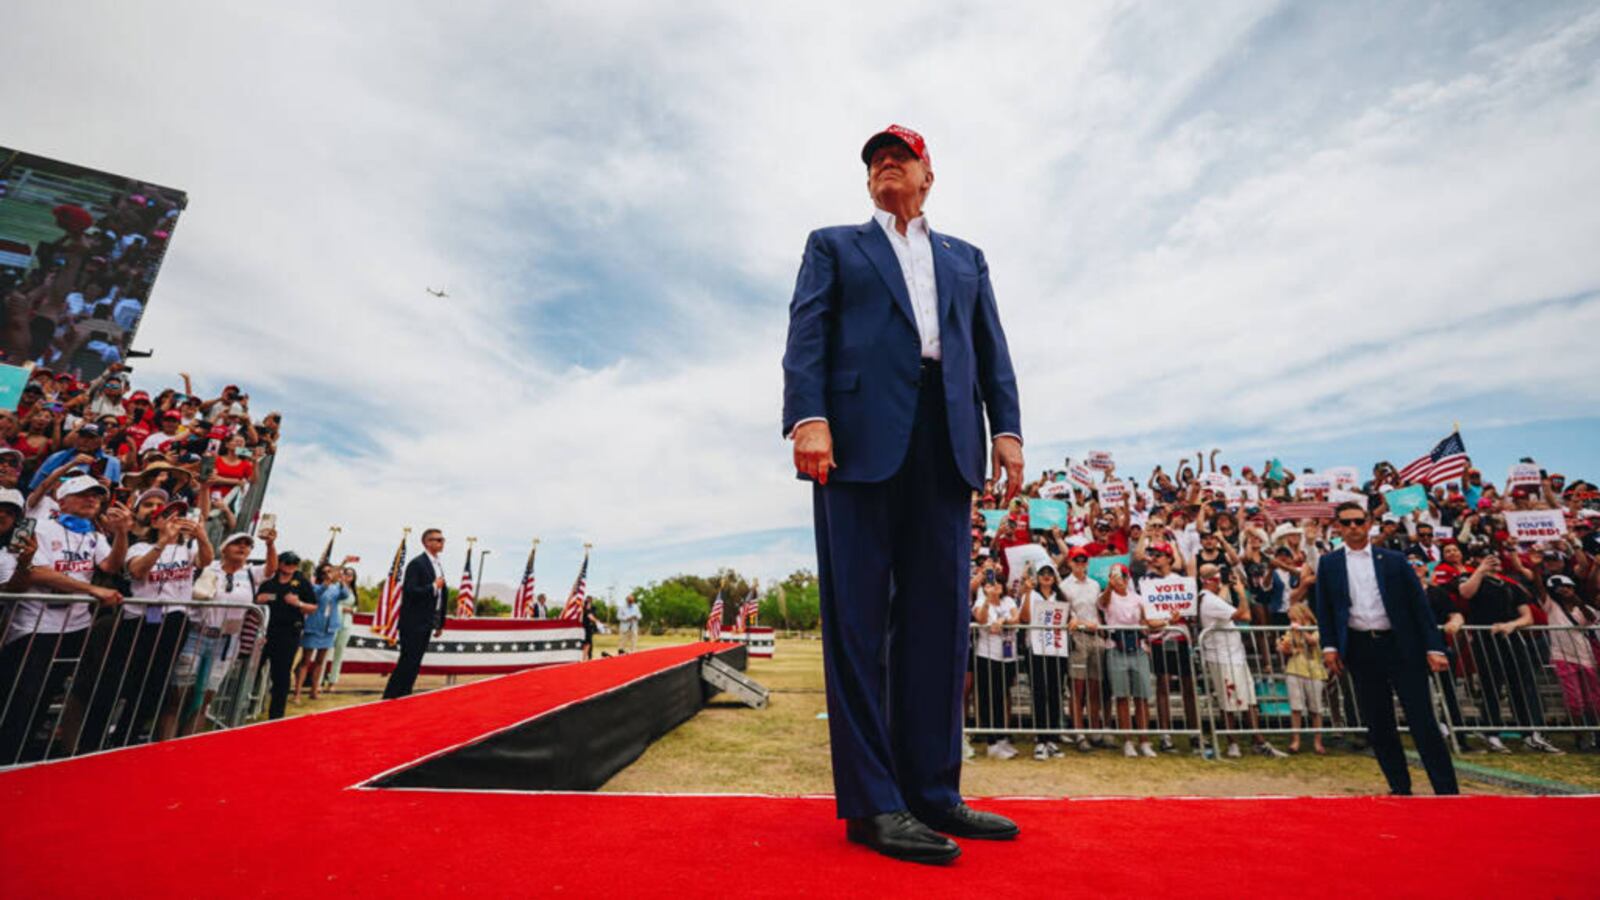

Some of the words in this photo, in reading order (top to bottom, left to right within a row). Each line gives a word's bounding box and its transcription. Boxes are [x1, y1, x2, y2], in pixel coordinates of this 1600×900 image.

[1516, 521, 1554, 529] YOU'RE
[1517, 528, 1560, 536] FIRED!
[1155, 584, 1185, 592] VOTE
[1148, 593, 1194, 603] DONALD
[1154, 602, 1192, 611] TRUMP
